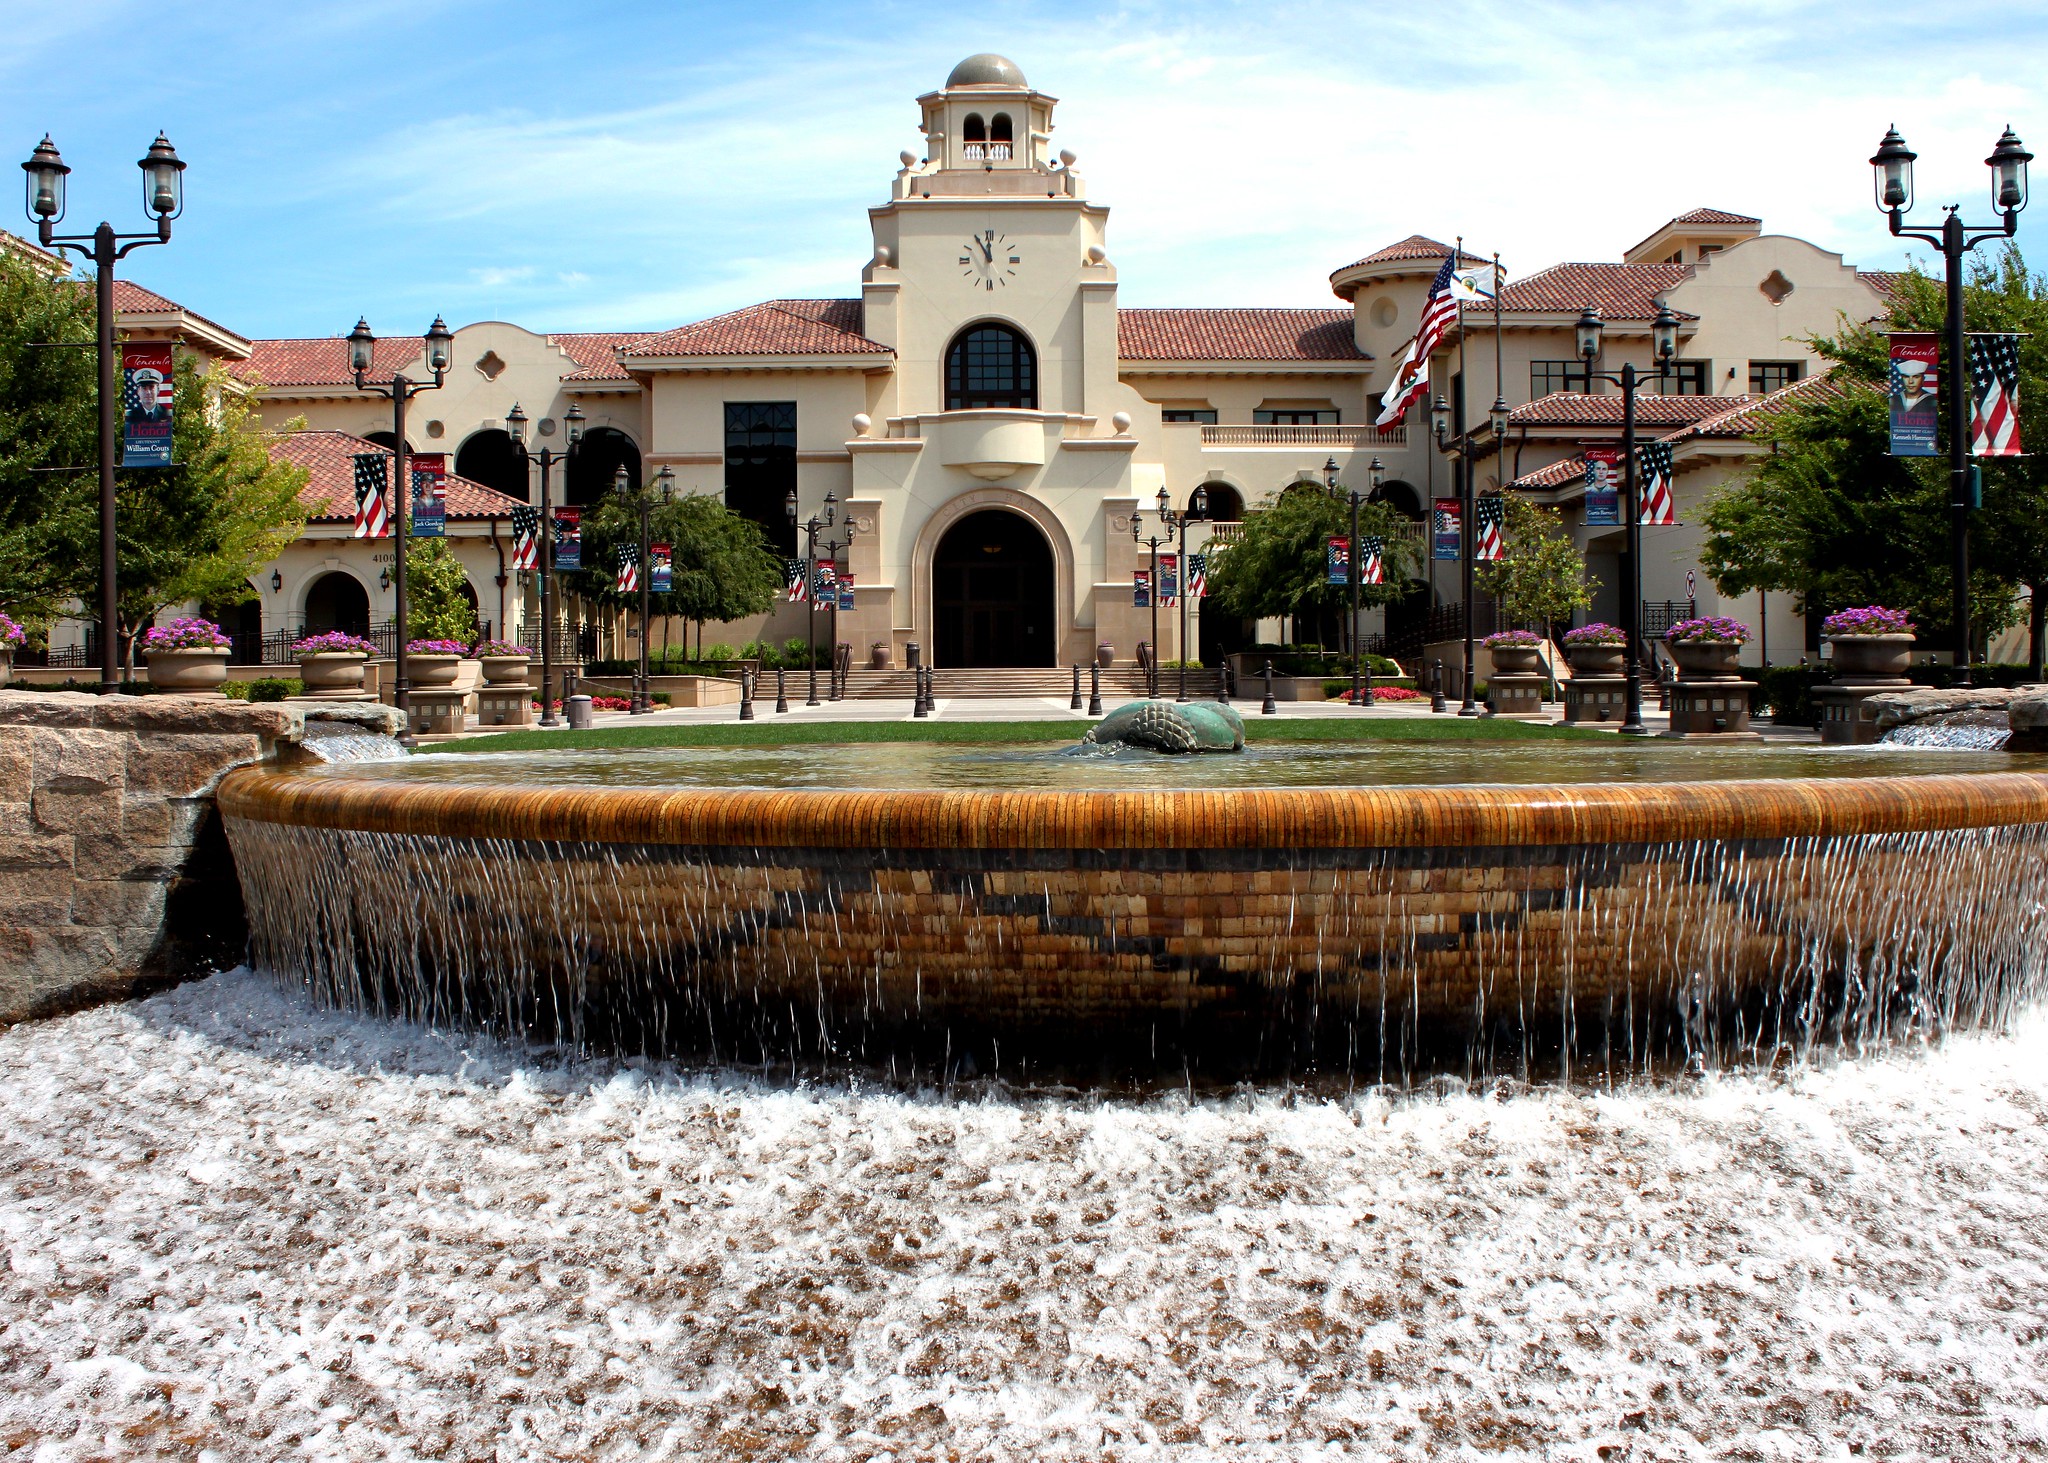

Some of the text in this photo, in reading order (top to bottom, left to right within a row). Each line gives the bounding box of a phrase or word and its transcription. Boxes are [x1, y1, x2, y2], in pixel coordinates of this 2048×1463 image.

[1891, 344, 1936, 357] Temecula
[125, 354, 171, 367] Temecula
[1897, 412, 1935, 425] Honor
[129, 423, 170, 436] Honor
[126, 444, 170, 452] William Couts
[943, 494, 1043, 517] CITY HALL
[372, 553, 396, 563] 4100
